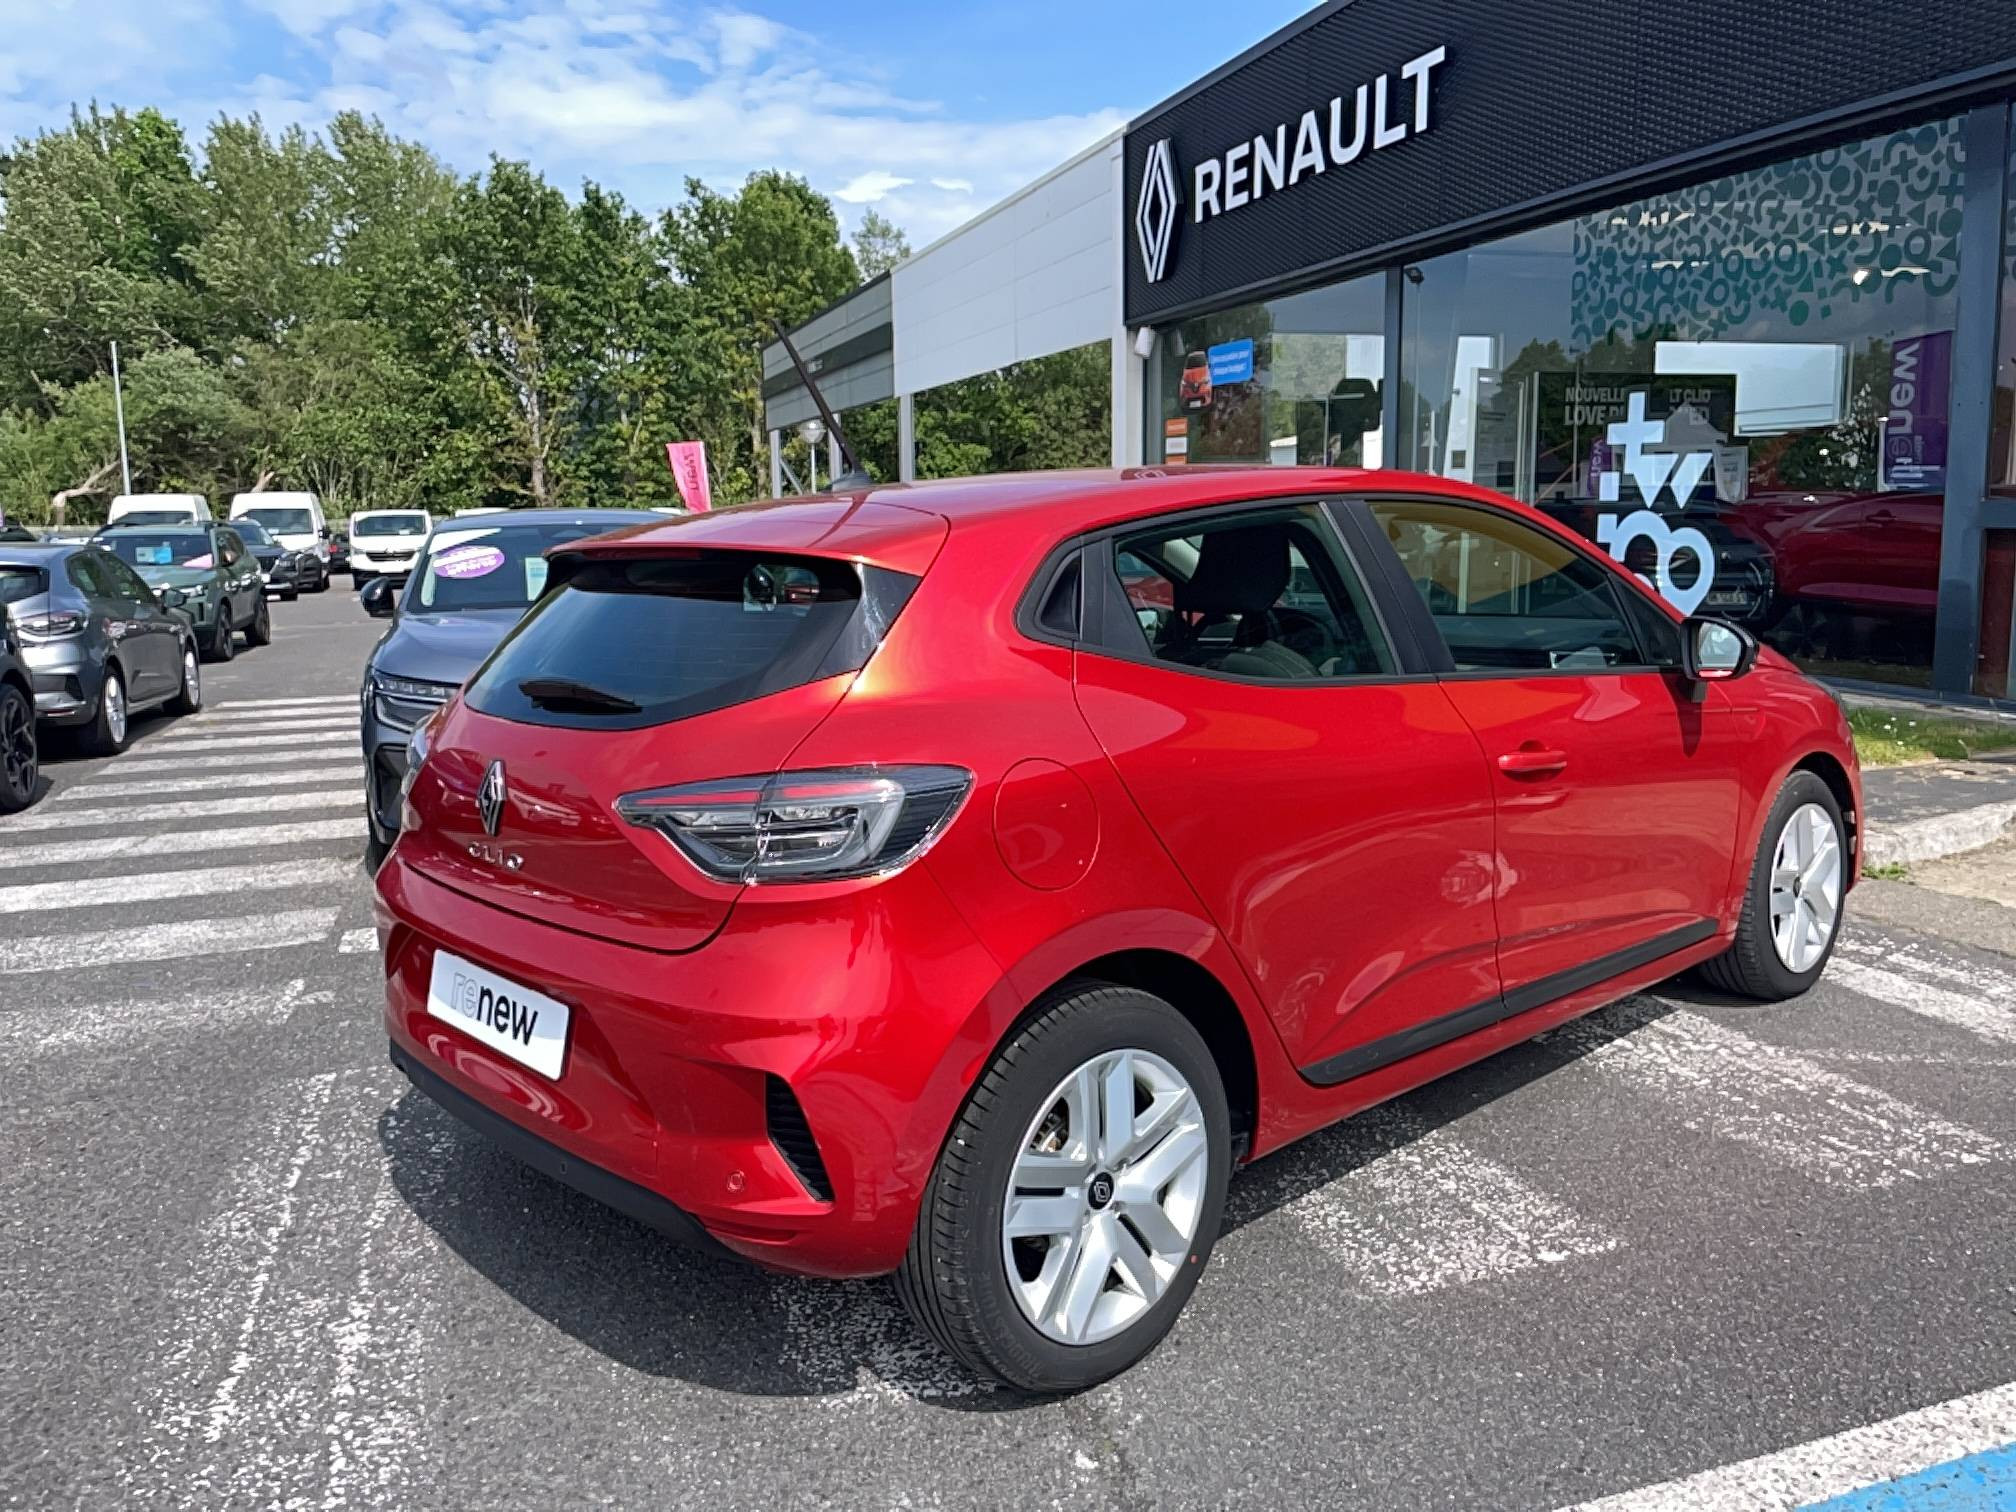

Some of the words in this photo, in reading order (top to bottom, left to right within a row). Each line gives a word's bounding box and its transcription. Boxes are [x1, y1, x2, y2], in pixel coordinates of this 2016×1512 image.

[1194, 45, 1446, 224] RENAULT
[1564, 404, 1606, 425] LOVE
[468, 841, 524, 871] CLIO
[451, 972, 538, 1046] renew
